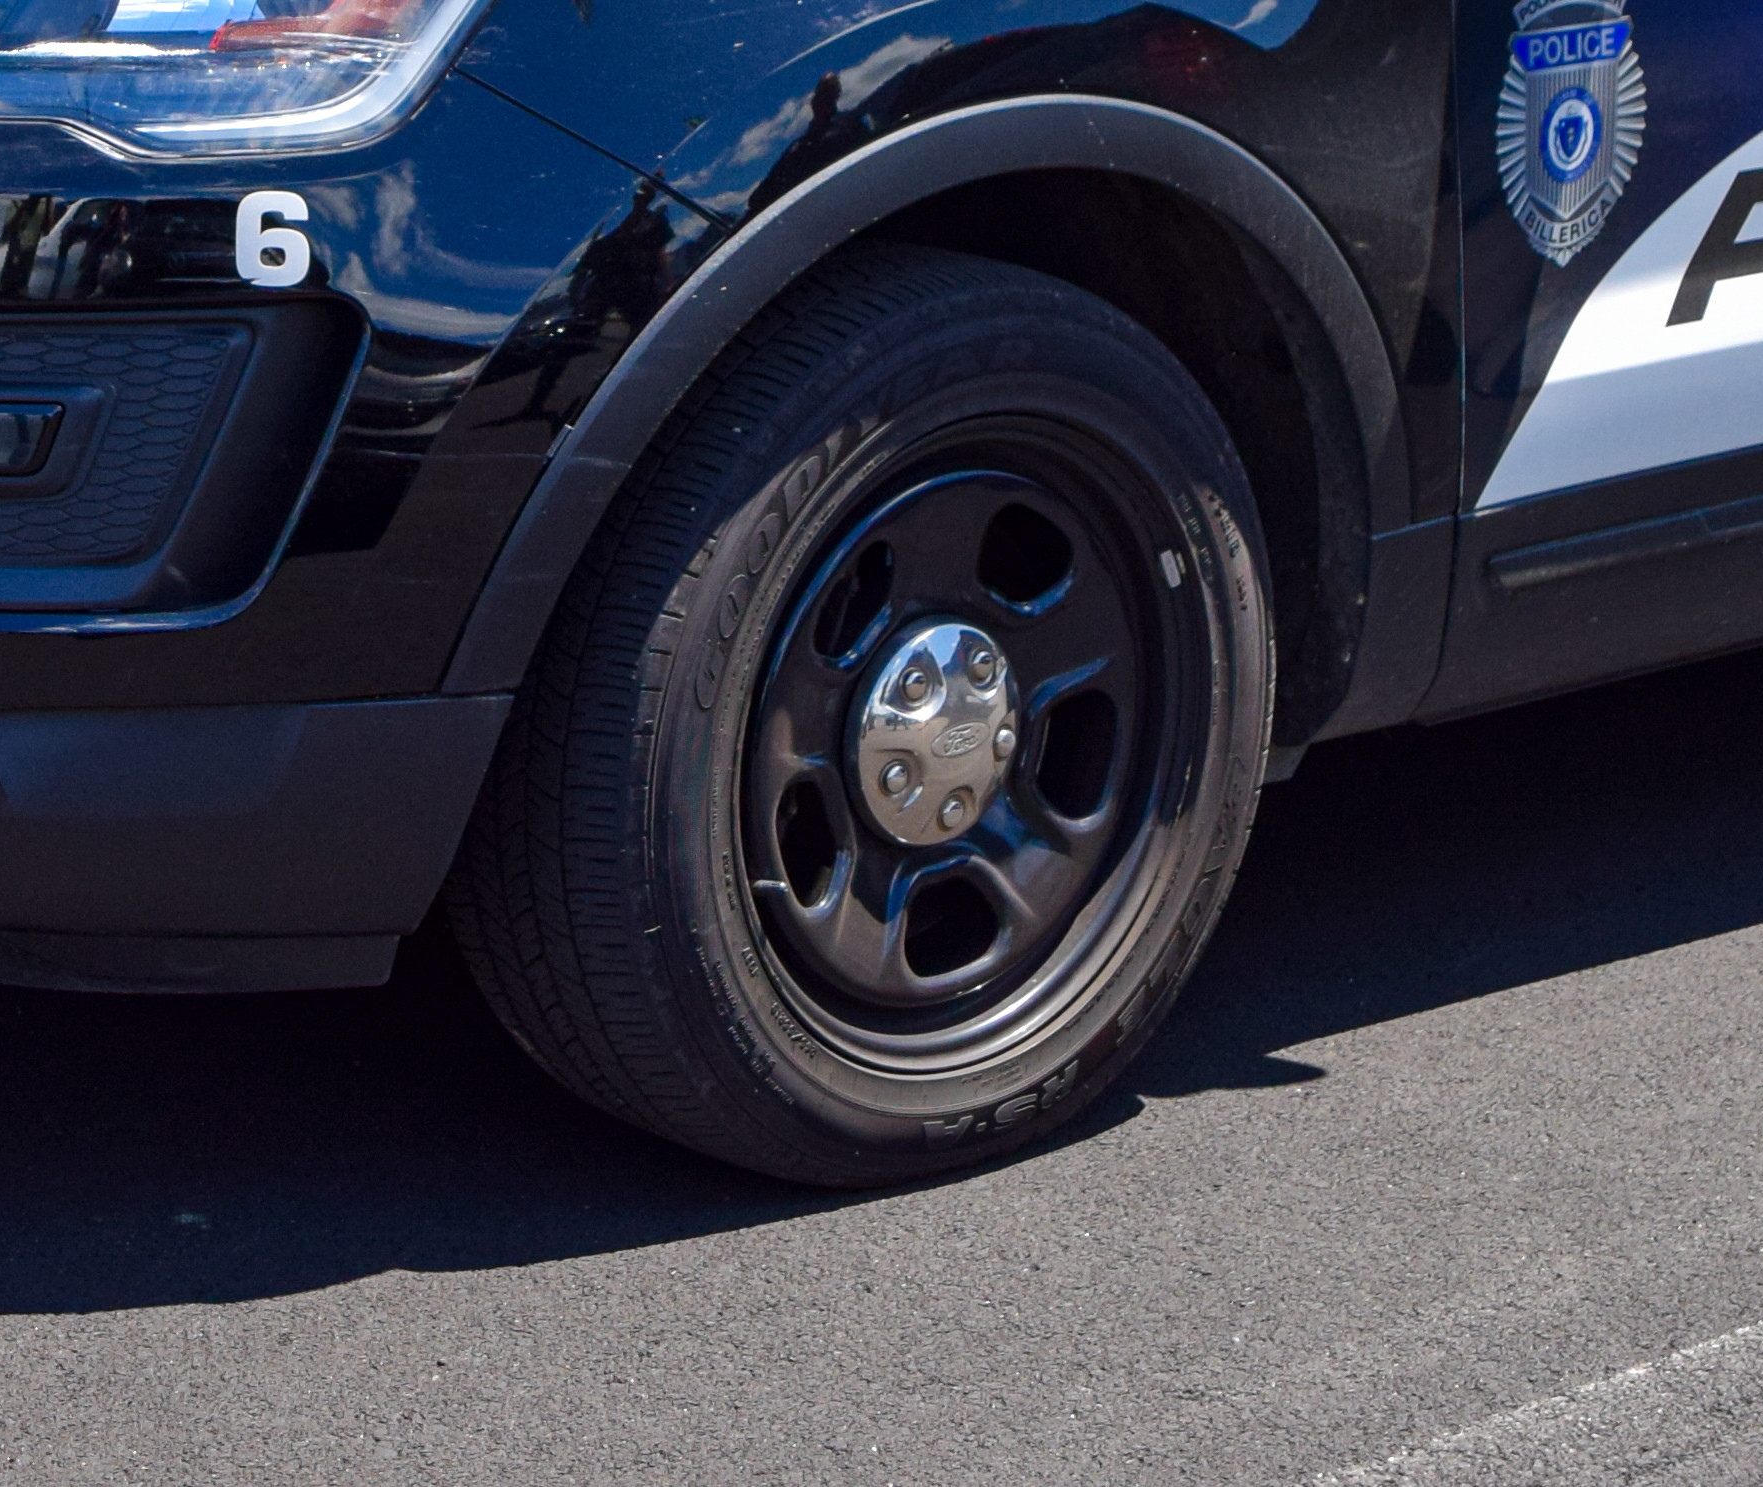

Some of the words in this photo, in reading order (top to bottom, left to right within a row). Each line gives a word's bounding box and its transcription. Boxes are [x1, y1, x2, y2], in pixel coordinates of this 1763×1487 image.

[1528, 26, 1616, 67] POLICE
[235, 190, 311, 287] 6
[1523, 197, 1612, 245] BILLERICA
